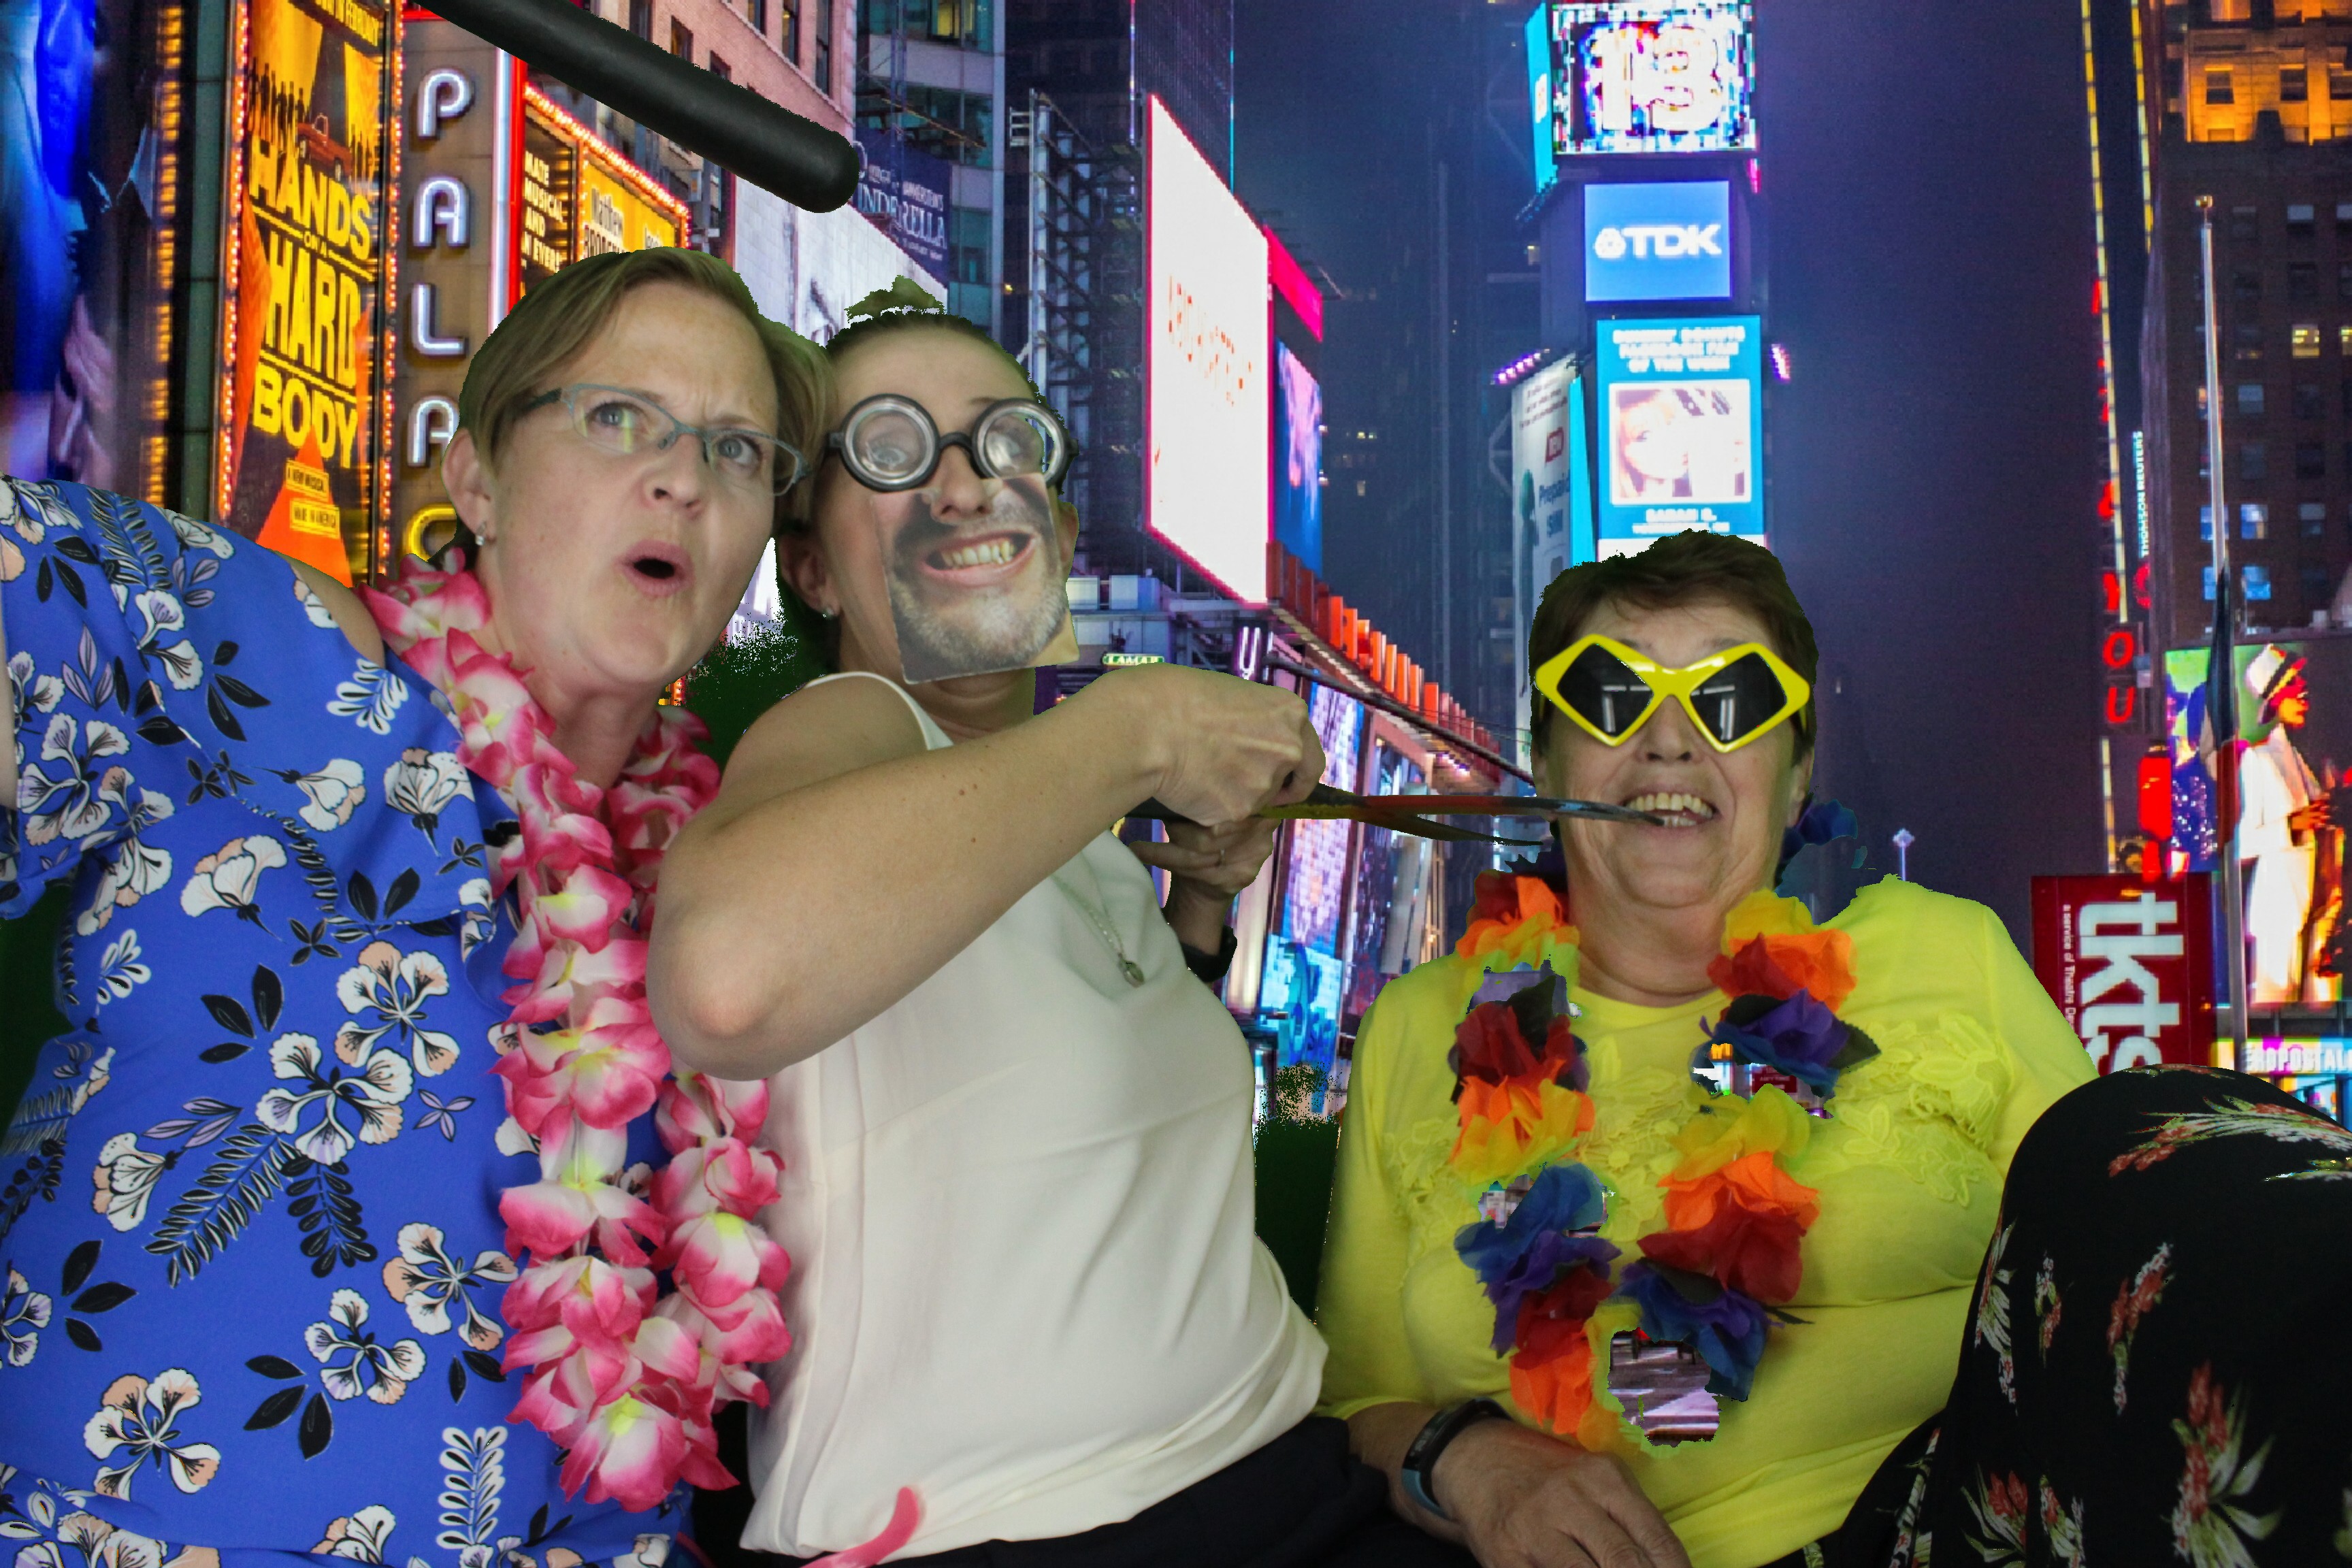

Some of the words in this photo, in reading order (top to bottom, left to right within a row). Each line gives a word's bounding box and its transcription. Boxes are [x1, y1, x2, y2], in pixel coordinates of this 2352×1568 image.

[249, 133, 370, 261] HANDS
[1622, 225, 1722, 255] TDK
[265, 231, 361, 389] HARD
[252, 361, 358, 469] BODY
[2063, 913, 2072, 950] service
[2063, 952, 2075, 963] of
[2079, 892, 2184, 1075] tkts
